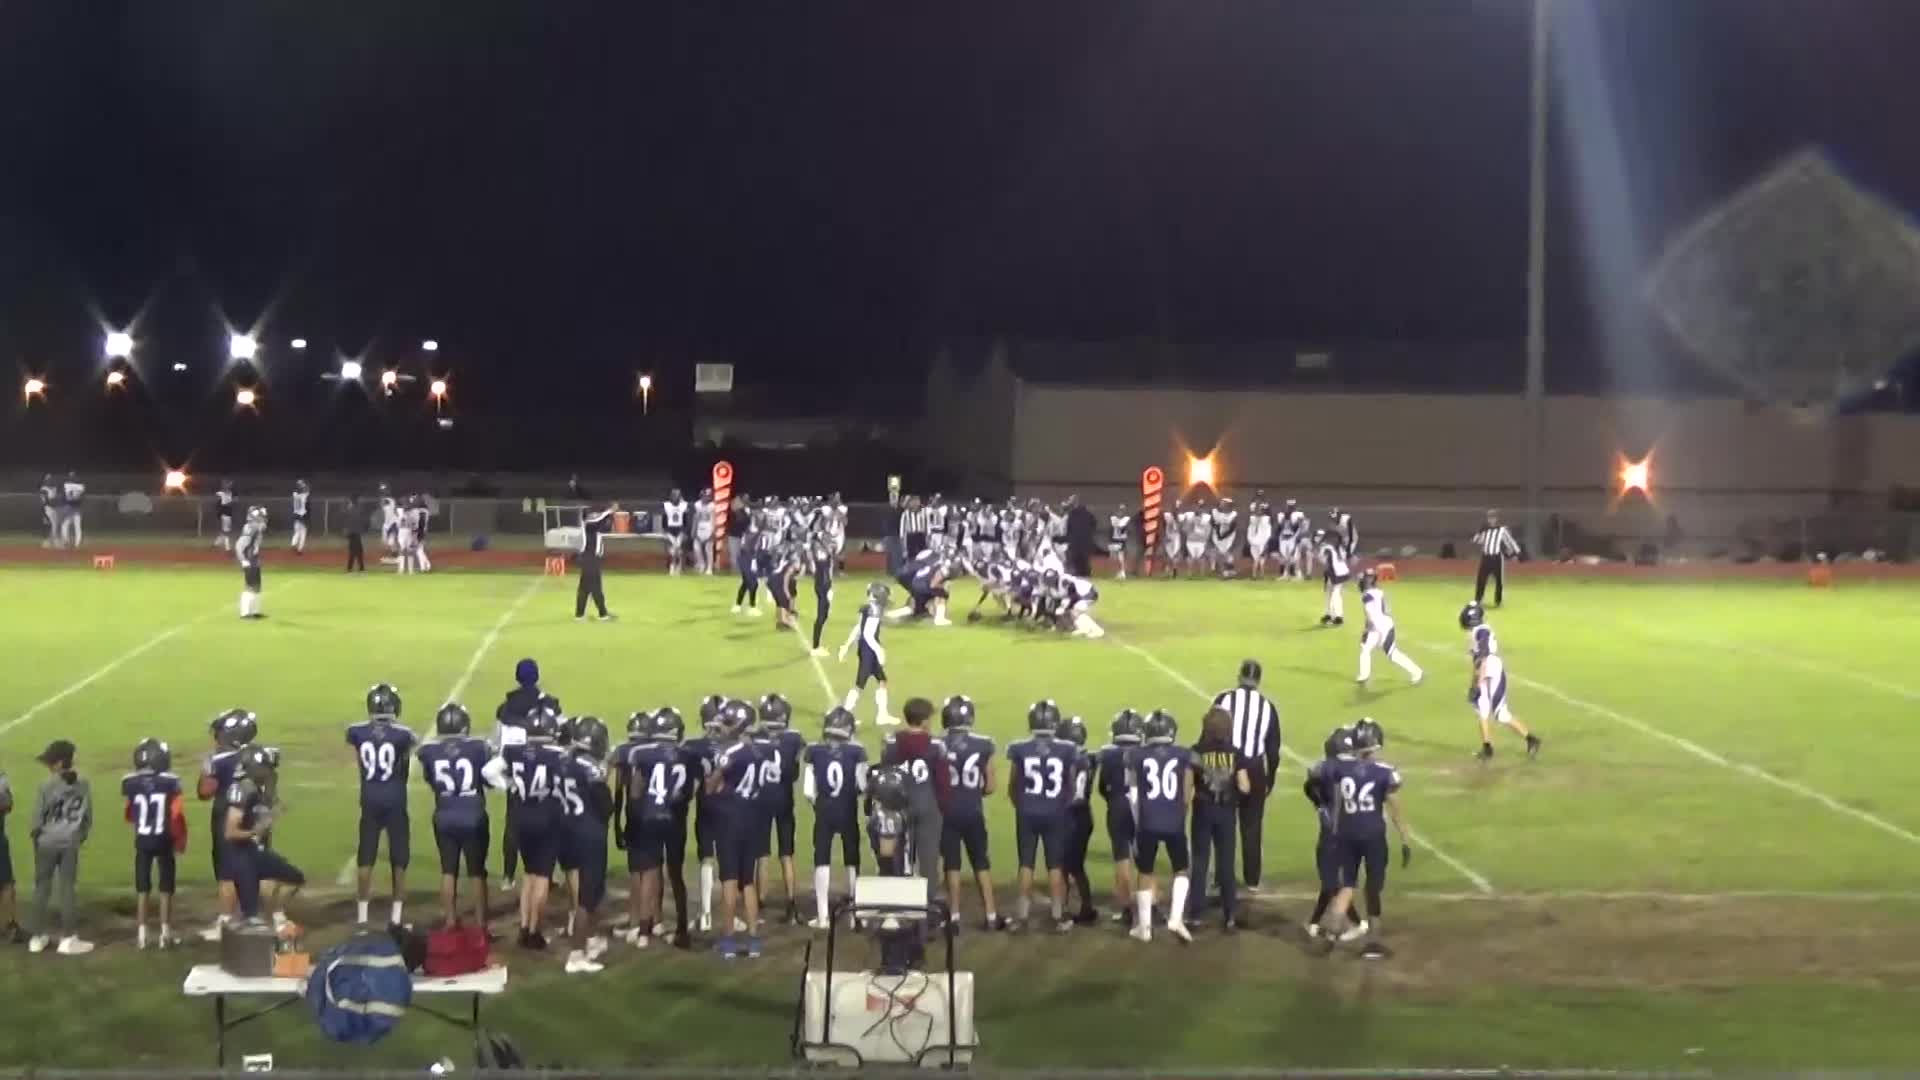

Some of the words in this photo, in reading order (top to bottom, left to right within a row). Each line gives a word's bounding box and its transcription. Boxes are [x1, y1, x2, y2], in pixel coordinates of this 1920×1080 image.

[360, 742, 395, 781] 99
[434, 758, 477, 797] 52
[512, 761, 550, 802] 54
[827, 761, 843, 797] 9
[1024, 757, 1064, 798] 53
[1142, 757, 1178, 800] 36
[648, 761, 687, 805] 42
[1340, 776, 1376, 814] 86
[134, 793, 167, 835] 27
